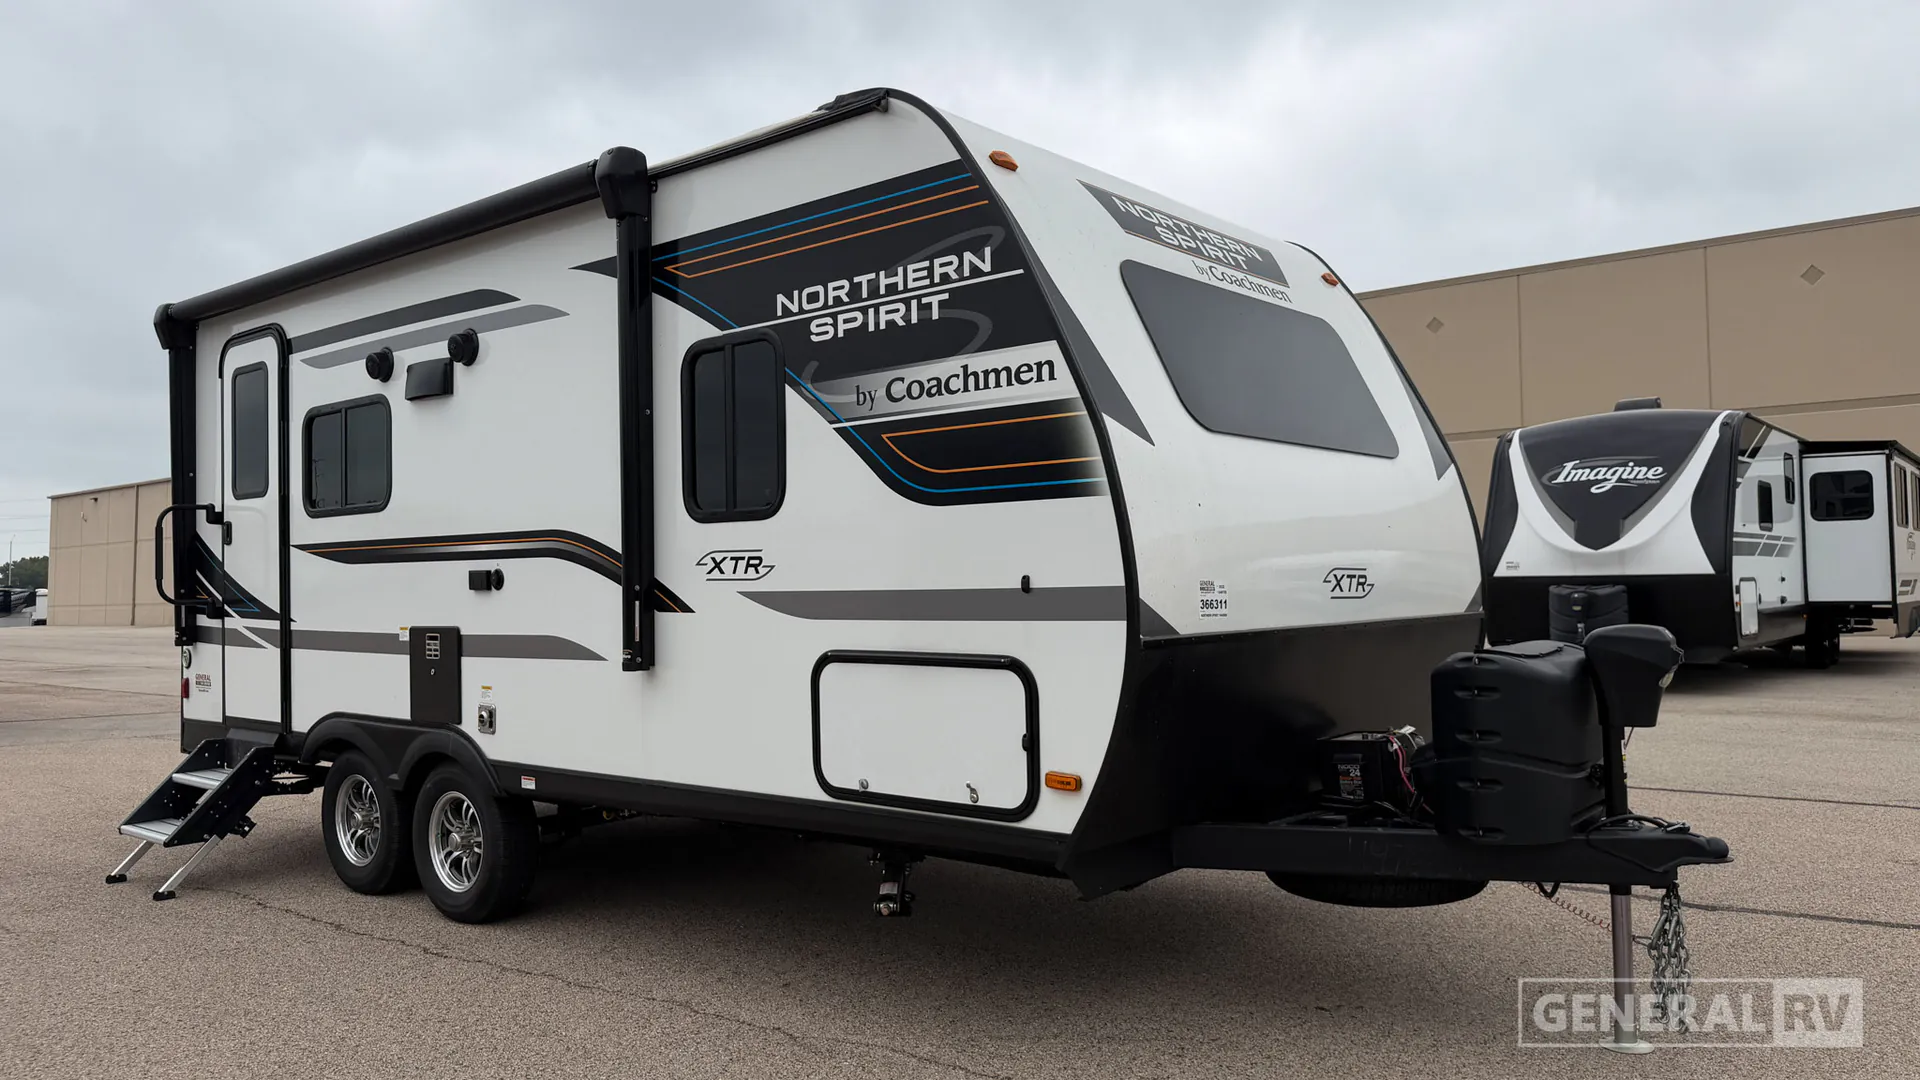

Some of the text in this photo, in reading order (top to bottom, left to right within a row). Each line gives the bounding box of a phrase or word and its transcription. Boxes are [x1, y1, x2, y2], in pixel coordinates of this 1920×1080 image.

[1111, 195, 1263, 262] NORTHERN
[1154, 225, 1248, 270] SPIRIT
[776, 246, 992, 316] NORTHERN
[1192, 260, 1293, 303] by Coachmen
[809, 293, 950, 342] SPIRIT
[855, 359, 1058, 411] by Coachmen
[1551, 460, 1668, 494] Imagine
[706, 556, 763, 574] XTR
[1200, 599, 1227, 610] 366311
